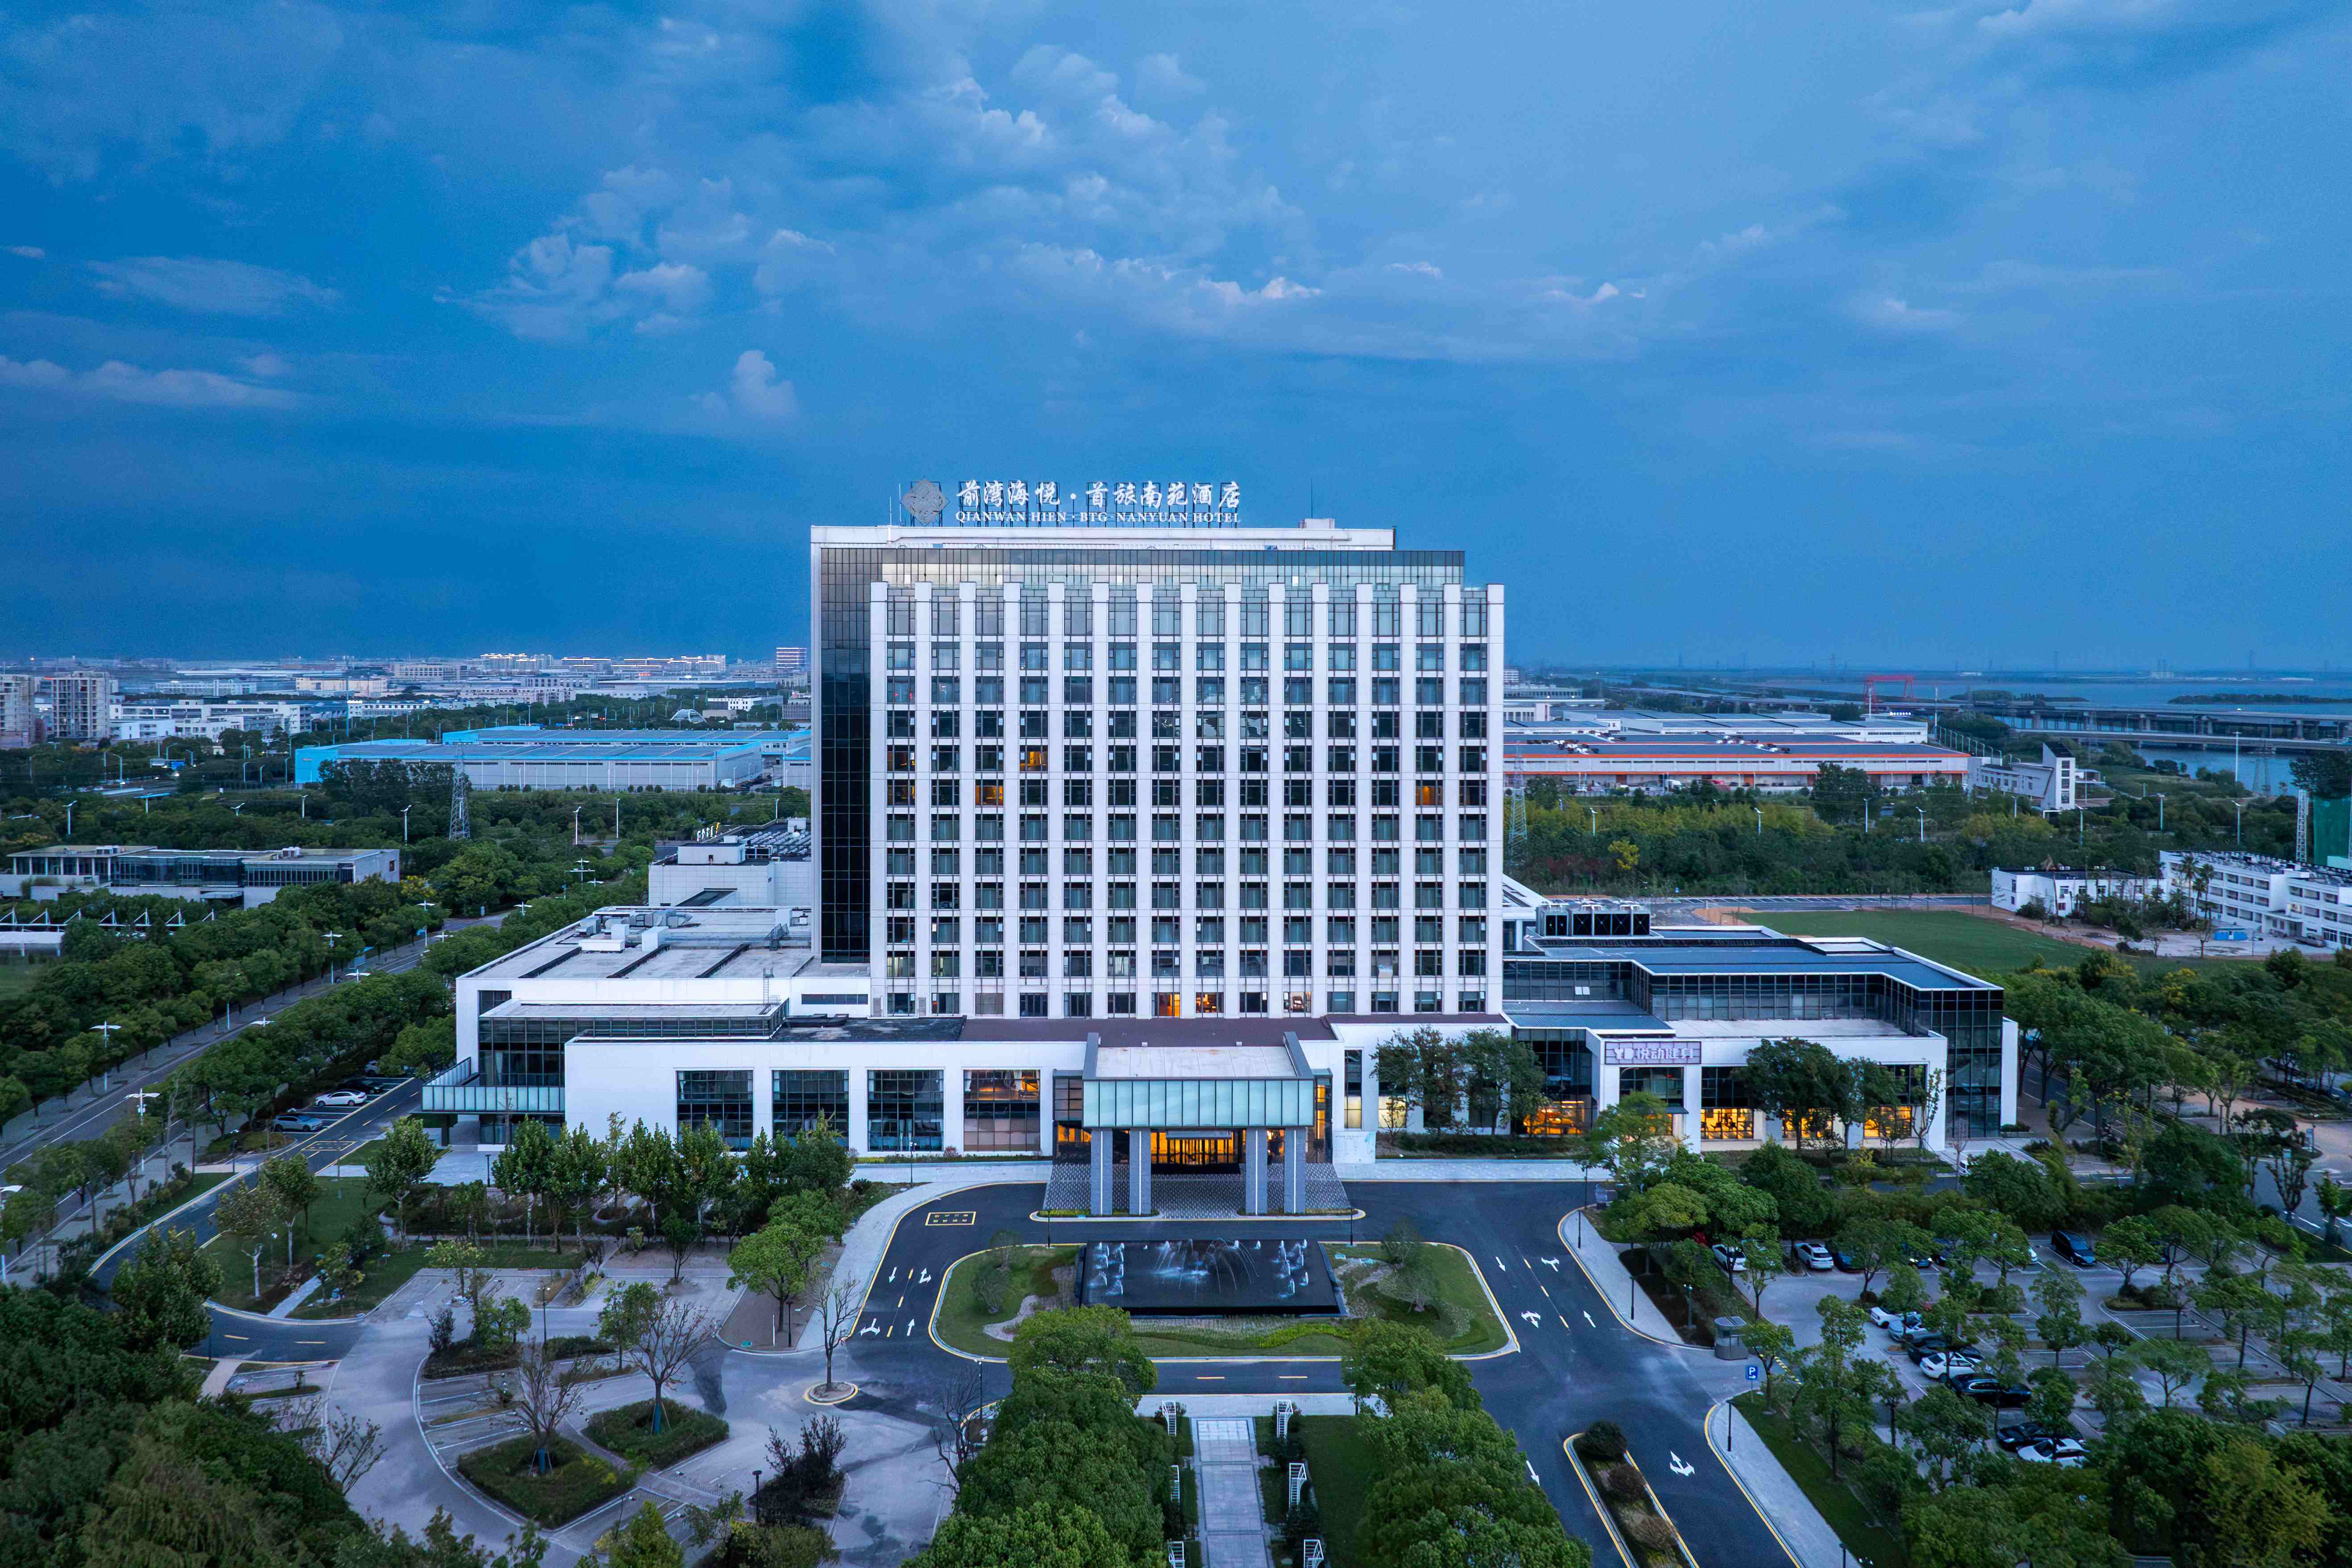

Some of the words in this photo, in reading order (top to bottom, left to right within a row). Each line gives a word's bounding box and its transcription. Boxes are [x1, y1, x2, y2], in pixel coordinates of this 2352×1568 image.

[956, 511, 1026, 522] QIANWAN
[1031, 512, 1067, 521] HIEN
[1193, 513, 1241, 522] HOTEL
[1749, 1367, 1756, 1375] P
